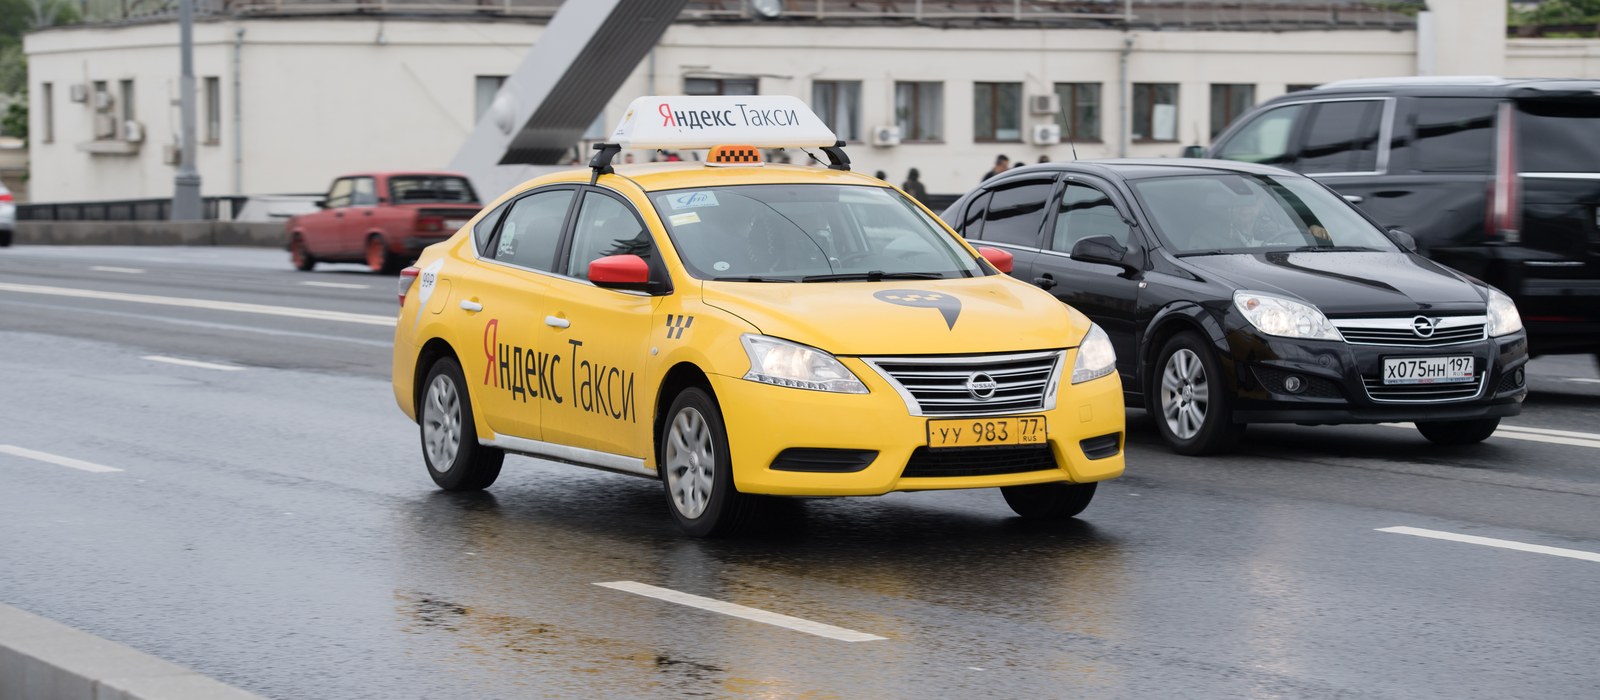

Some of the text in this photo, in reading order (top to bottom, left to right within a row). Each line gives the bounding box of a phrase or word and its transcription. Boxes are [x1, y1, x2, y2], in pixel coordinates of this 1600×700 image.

[658, 103, 799, 129] Яндекс Такси
[484, 319, 636, 423] Яндекс Такси
[1449, 358, 1471, 371] 197
[972, 421, 1008, 443] 983
[1020, 419, 1038, 435] 77
